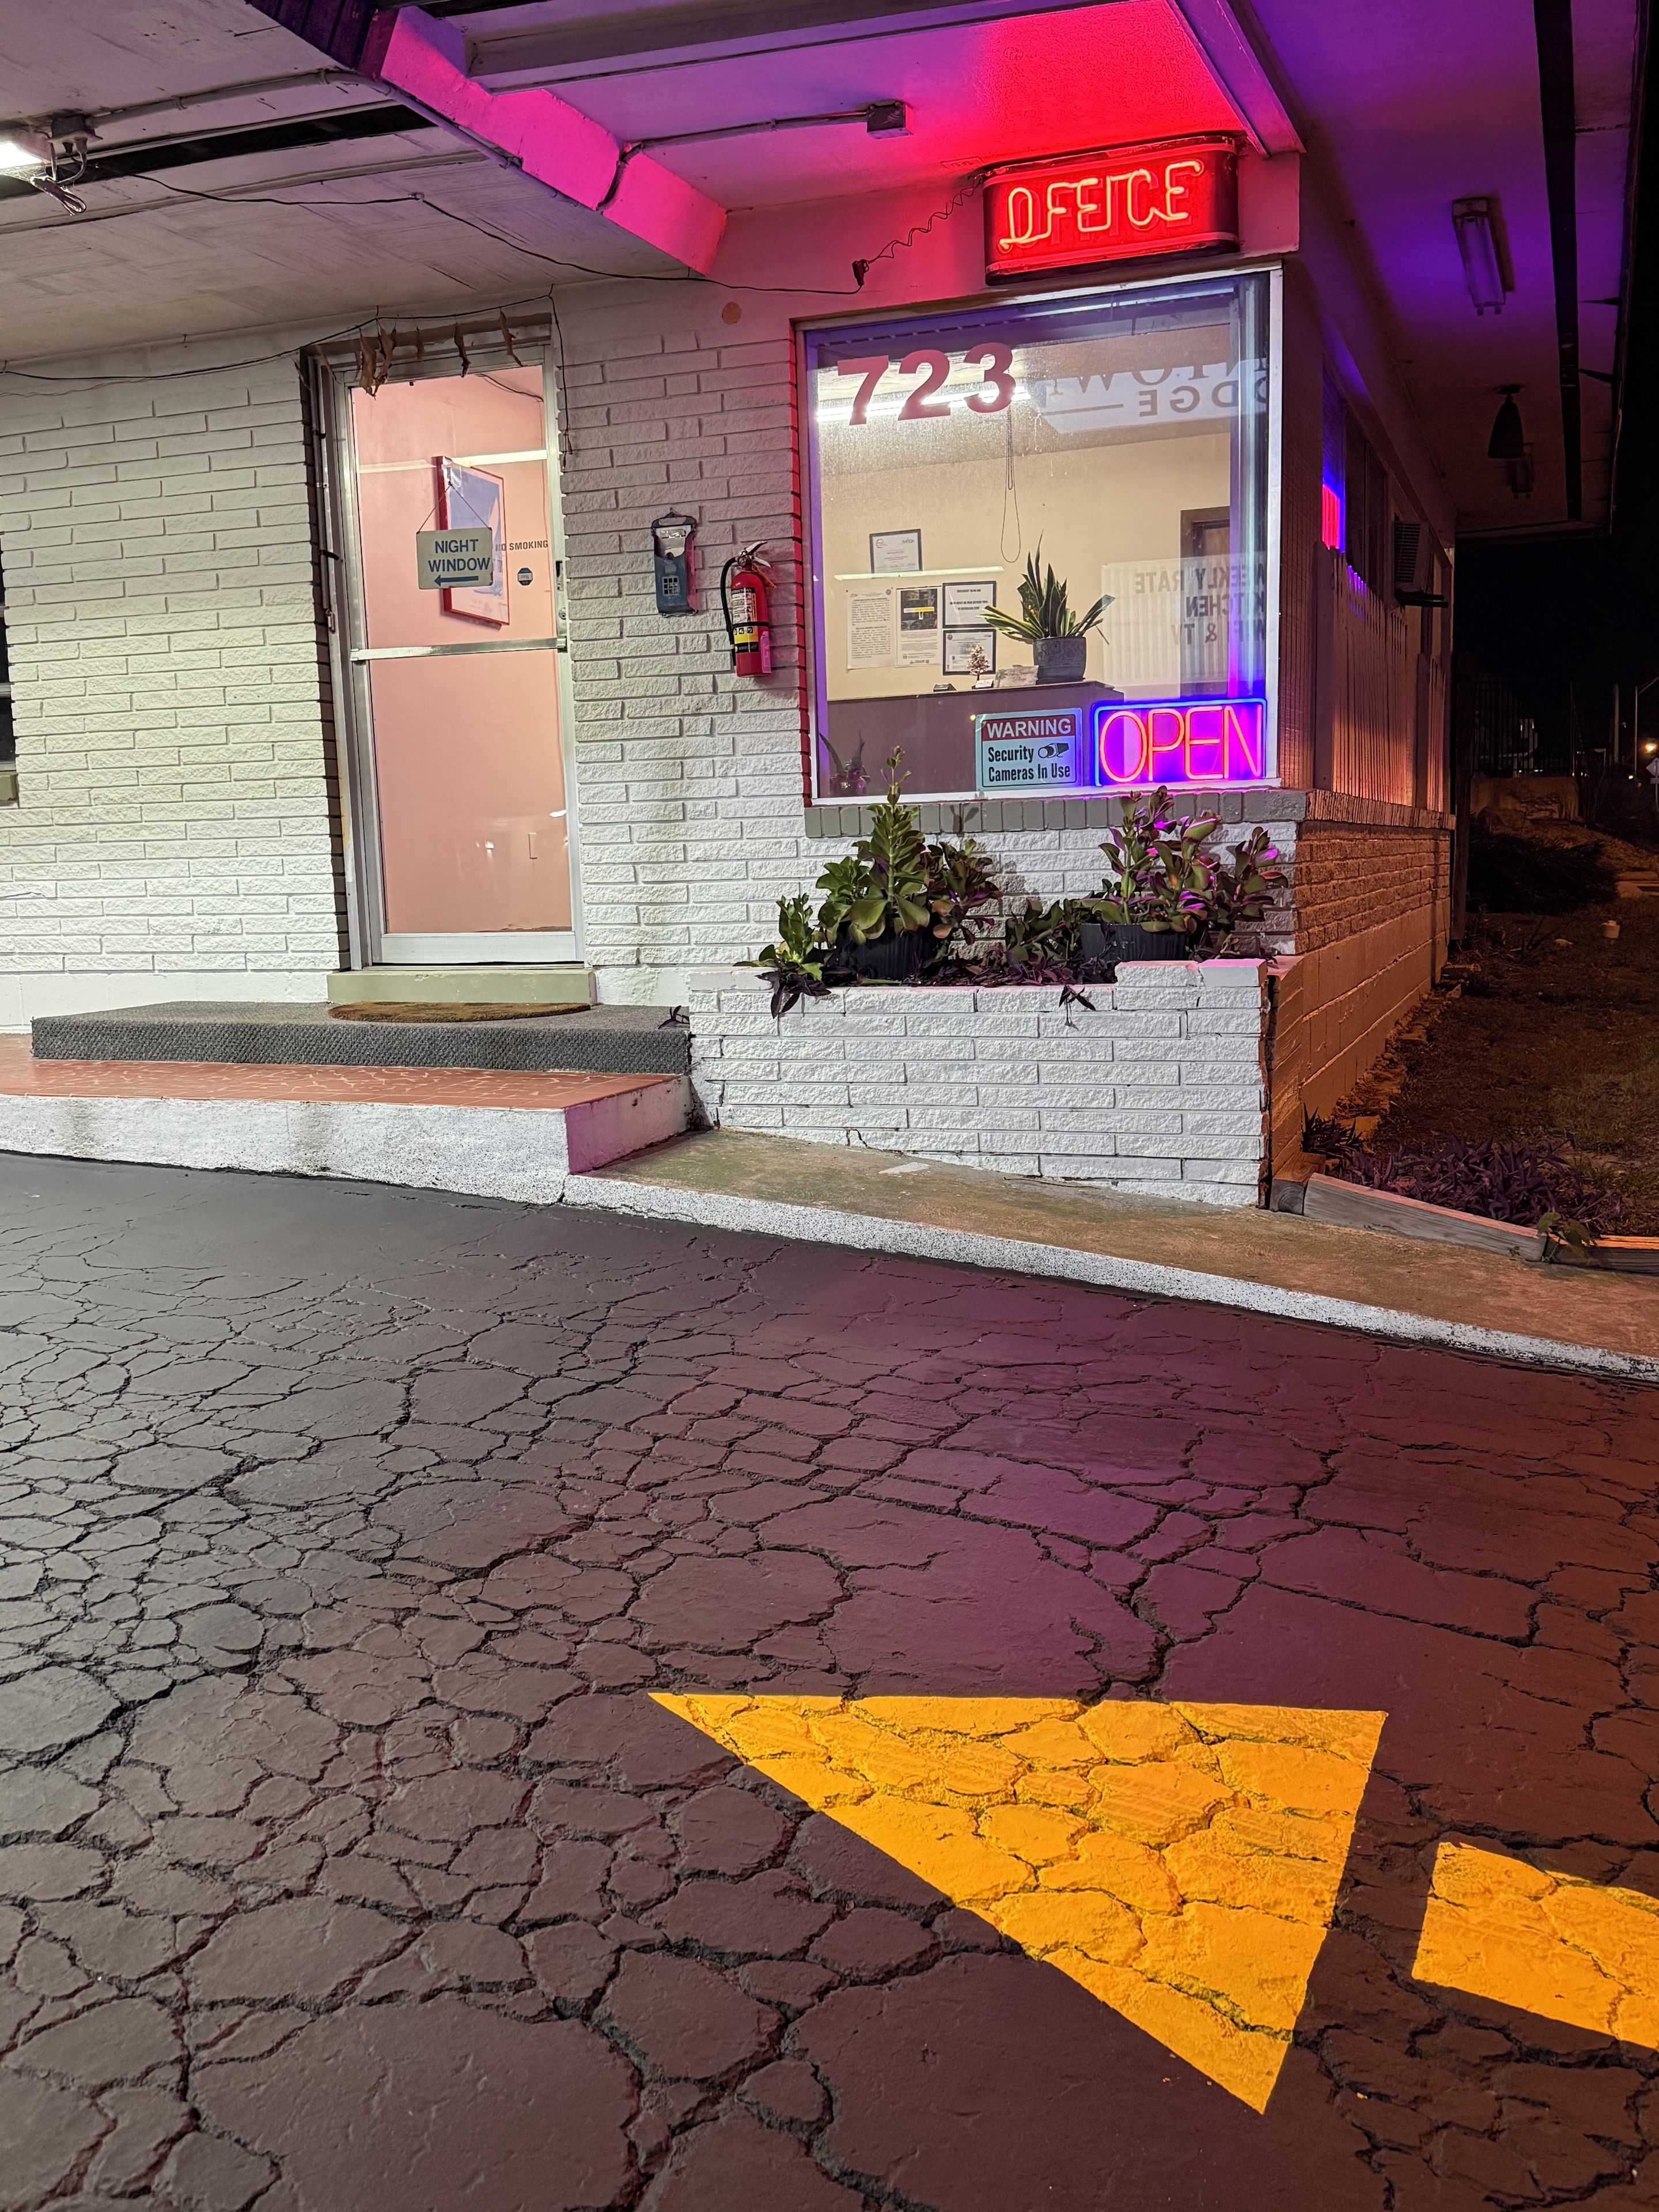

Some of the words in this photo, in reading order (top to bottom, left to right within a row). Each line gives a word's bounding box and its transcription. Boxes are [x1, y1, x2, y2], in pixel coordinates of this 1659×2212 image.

[999, 160, 1204, 252] OFFICE
[838, 343, 1016, 425] 723
[435, 539, 479, 554] NIGHT
[509, 540, 548, 550] SMOKING
[428, 558, 490, 572] WINDOW
[987, 718, 1071, 738] WARNING
[1100, 706, 1262, 782] OPEN
[988, 745, 1033, 763] Security
[988, 766, 1034, 782] Cameras
[1037, 764, 1048, 779] In
[1051, 763, 1070, 778] Use
